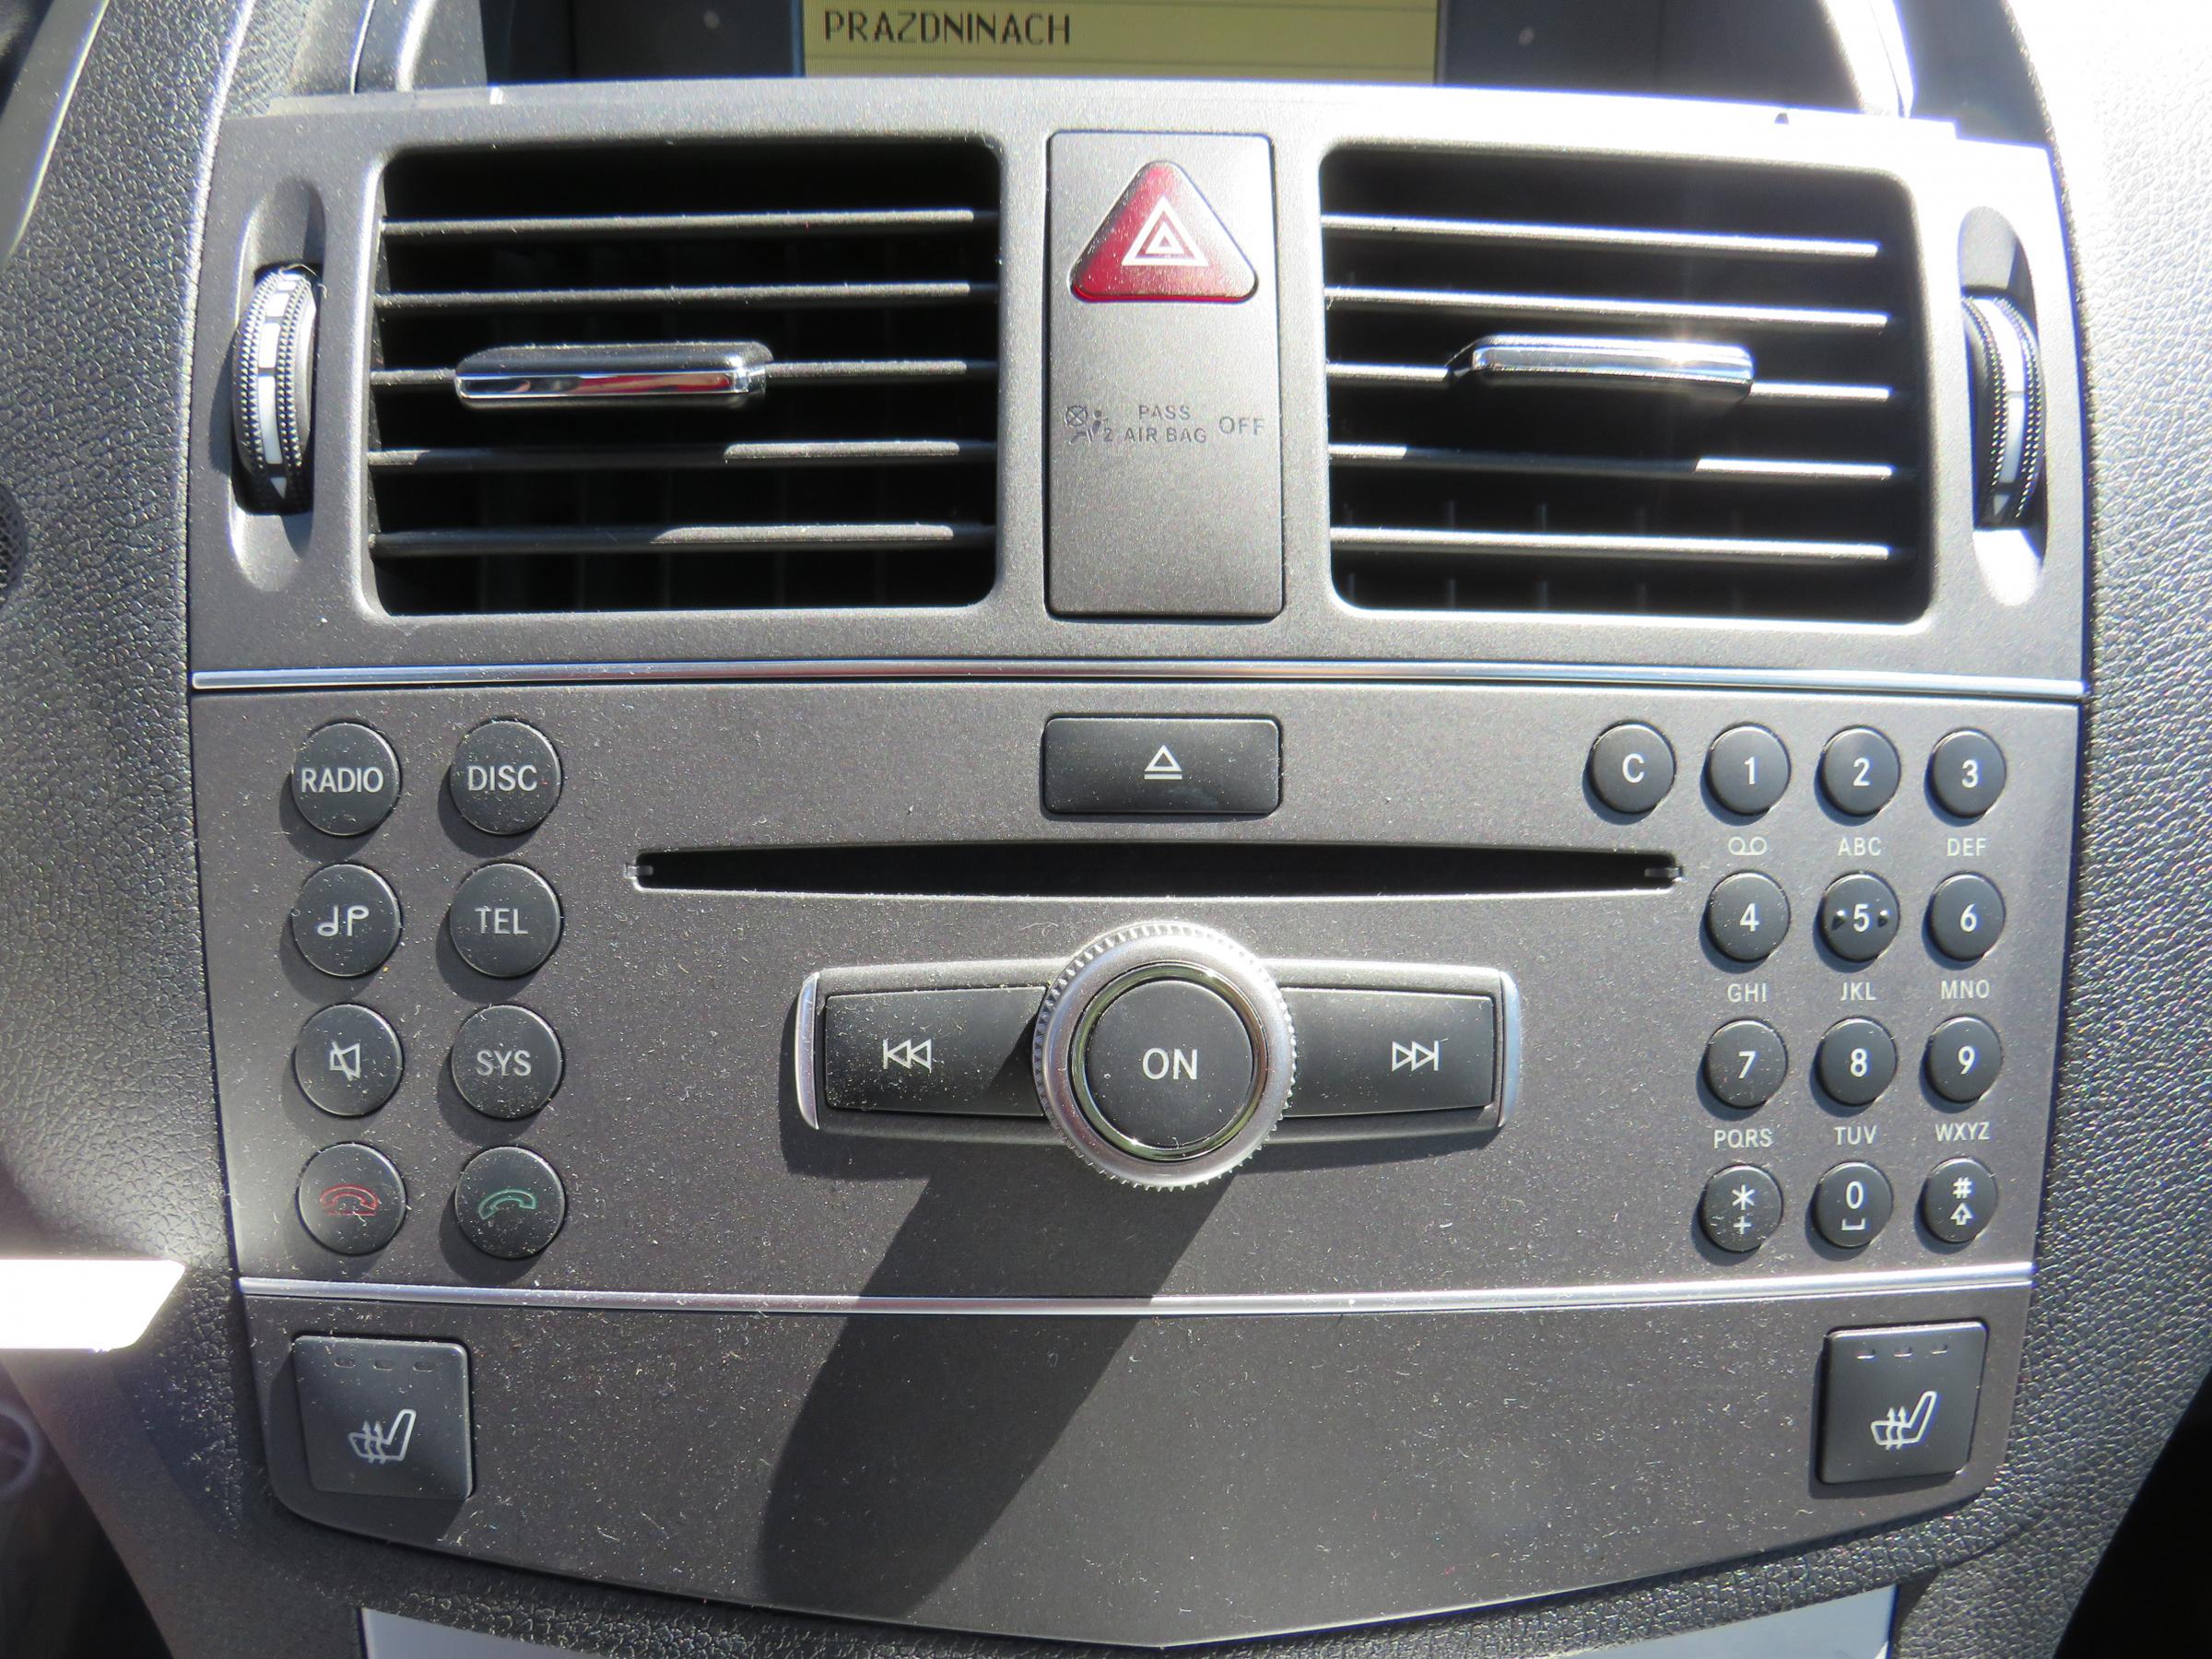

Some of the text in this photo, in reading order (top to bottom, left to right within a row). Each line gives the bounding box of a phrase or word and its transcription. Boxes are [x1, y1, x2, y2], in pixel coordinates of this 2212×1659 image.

[824, 10, 1070, 44] PRAZDNINACH
[1138, 405, 1191, 420] PASS
[1219, 416, 1265, 435] OFF
[1124, 428, 1158, 442] AIR
[1165, 428, 1206, 443] BAG
[300, 767, 383, 793] RADIO
[467, 765, 537, 792] DISC
[1622, 753, 1645, 783] C
[1745, 756, 1757, 784] 1
[1853, 758, 1870, 786] 2
[1961, 759, 1979, 788] 3
[1838, 837, 1882, 857] ABC
[1947, 838, 1987, 856] DEF
[475, 907, 528, 935] TEL
[1739, 903, 1759, 932] 4
[1853, 903, 1869, 932] 5
[1959, 904, 1977, 932] 6
[1727, 983, 1767, 1002] GHI
[1840, 982, 1877, 1001] JKL
[1941, 981, 1990, 999] MNO
[476, 1050, 532, 1077] SYS
[1142, 1047, 1198, 1079] ON
[1738, 1051, 1756, 1079] 7
[1850, 1048, 1867, 1077] 8
[1958, 1045, 1975, 1075] 9
[1713, 1129, 1773, 1148] PQRS
[1834, 1125, 1877, 1145] TUV
[1936, 1123, 1990, 1142] WXYZ
[1846, 1181, 1864, 1209] 0
